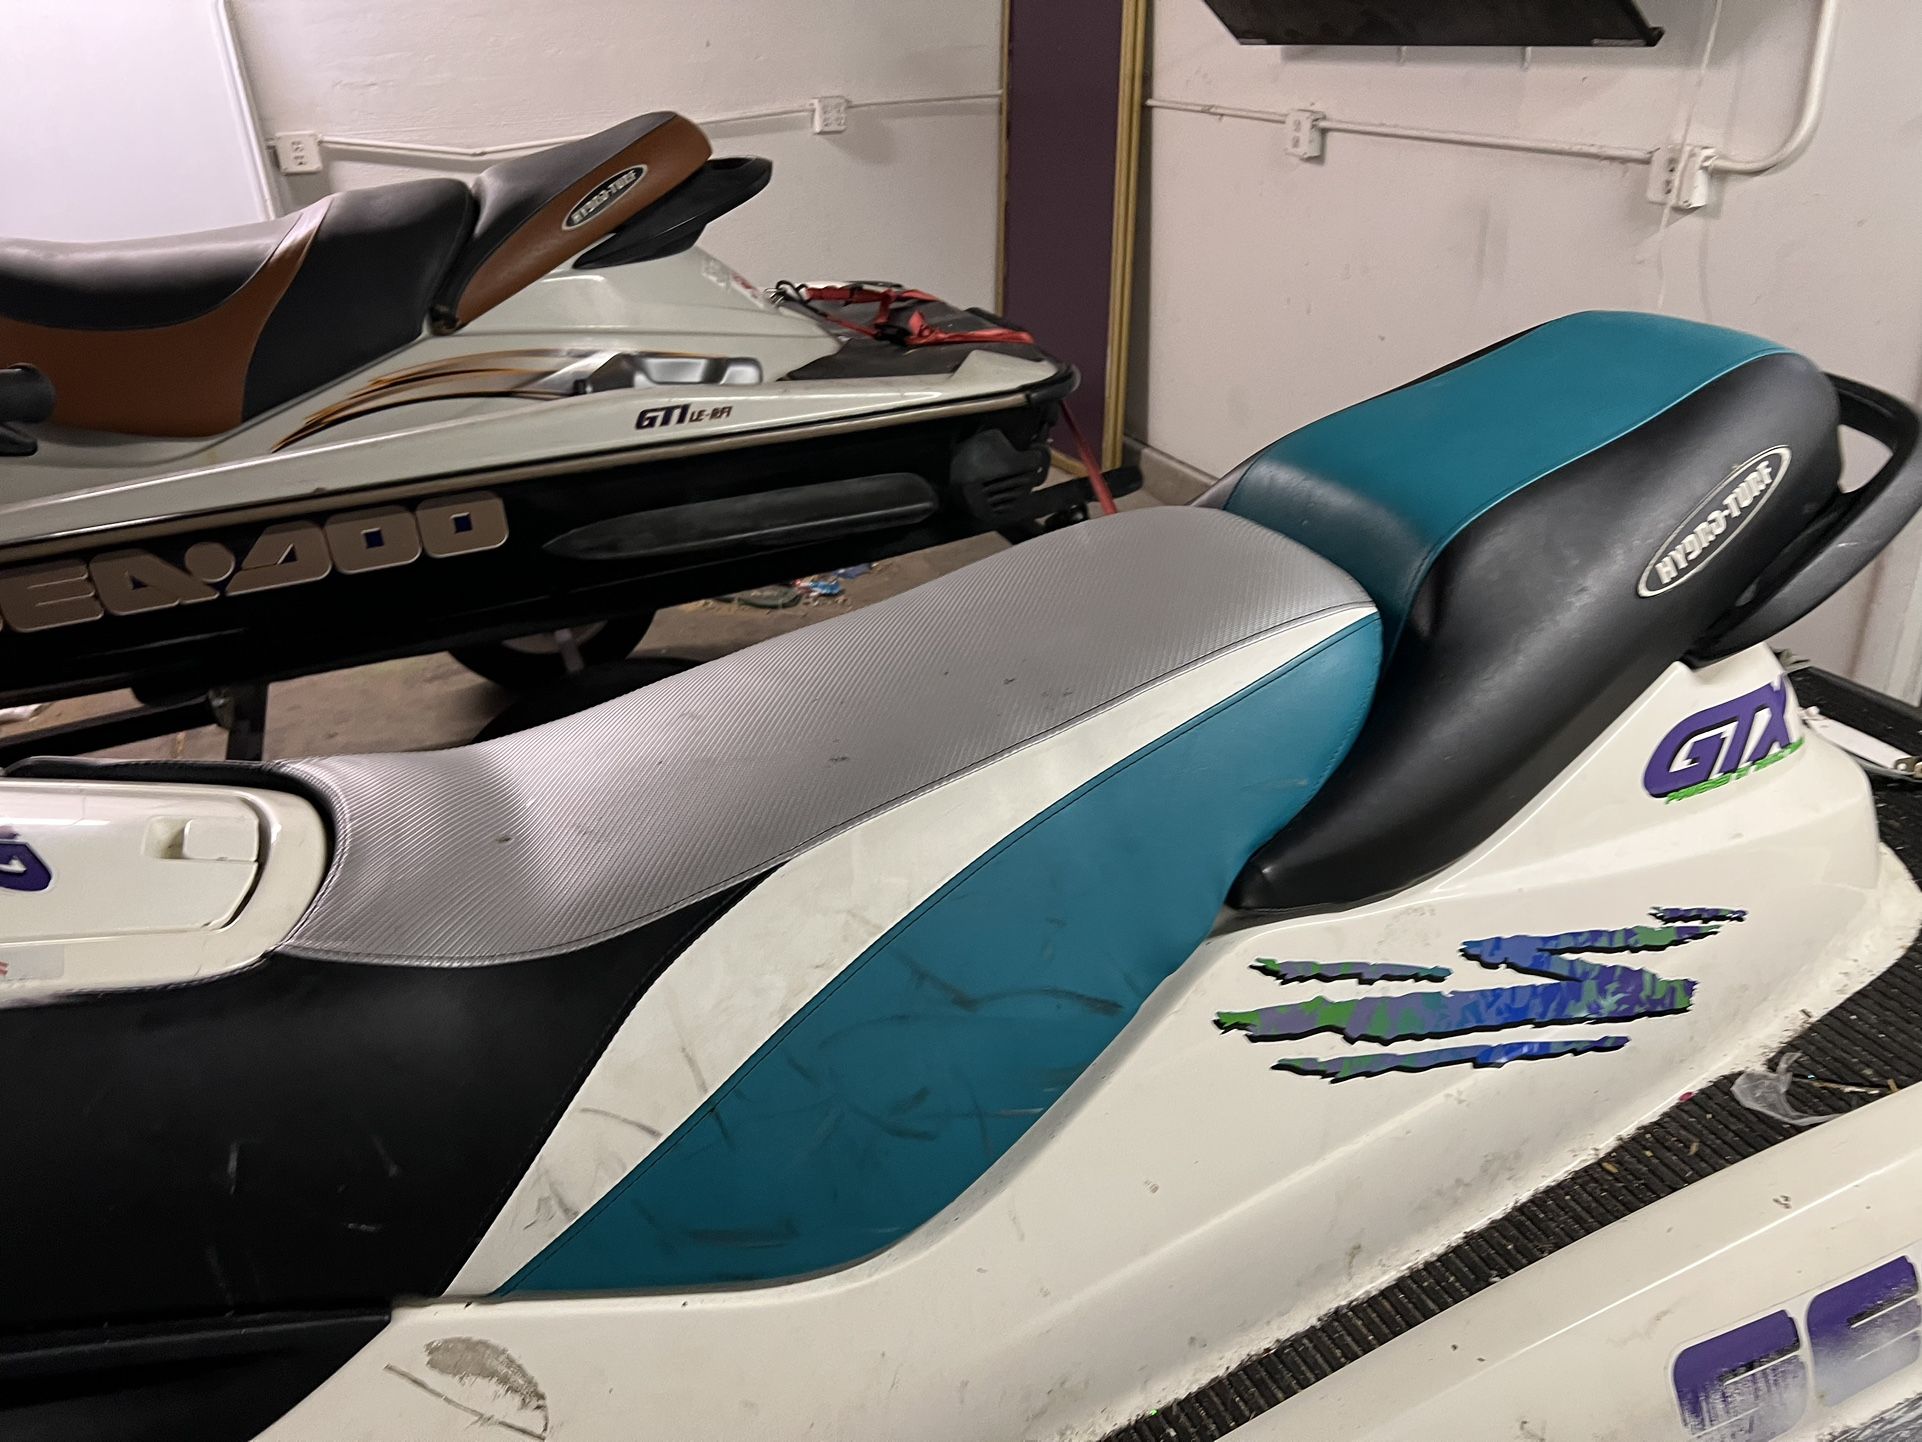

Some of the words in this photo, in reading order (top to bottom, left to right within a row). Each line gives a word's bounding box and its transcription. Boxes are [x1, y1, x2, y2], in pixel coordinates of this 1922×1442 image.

[635, 403, 691, 430] GTI
[1655, 460, 1772, 584] HYDRO-TURF
[1643, 673, 1792, 798] GTX
